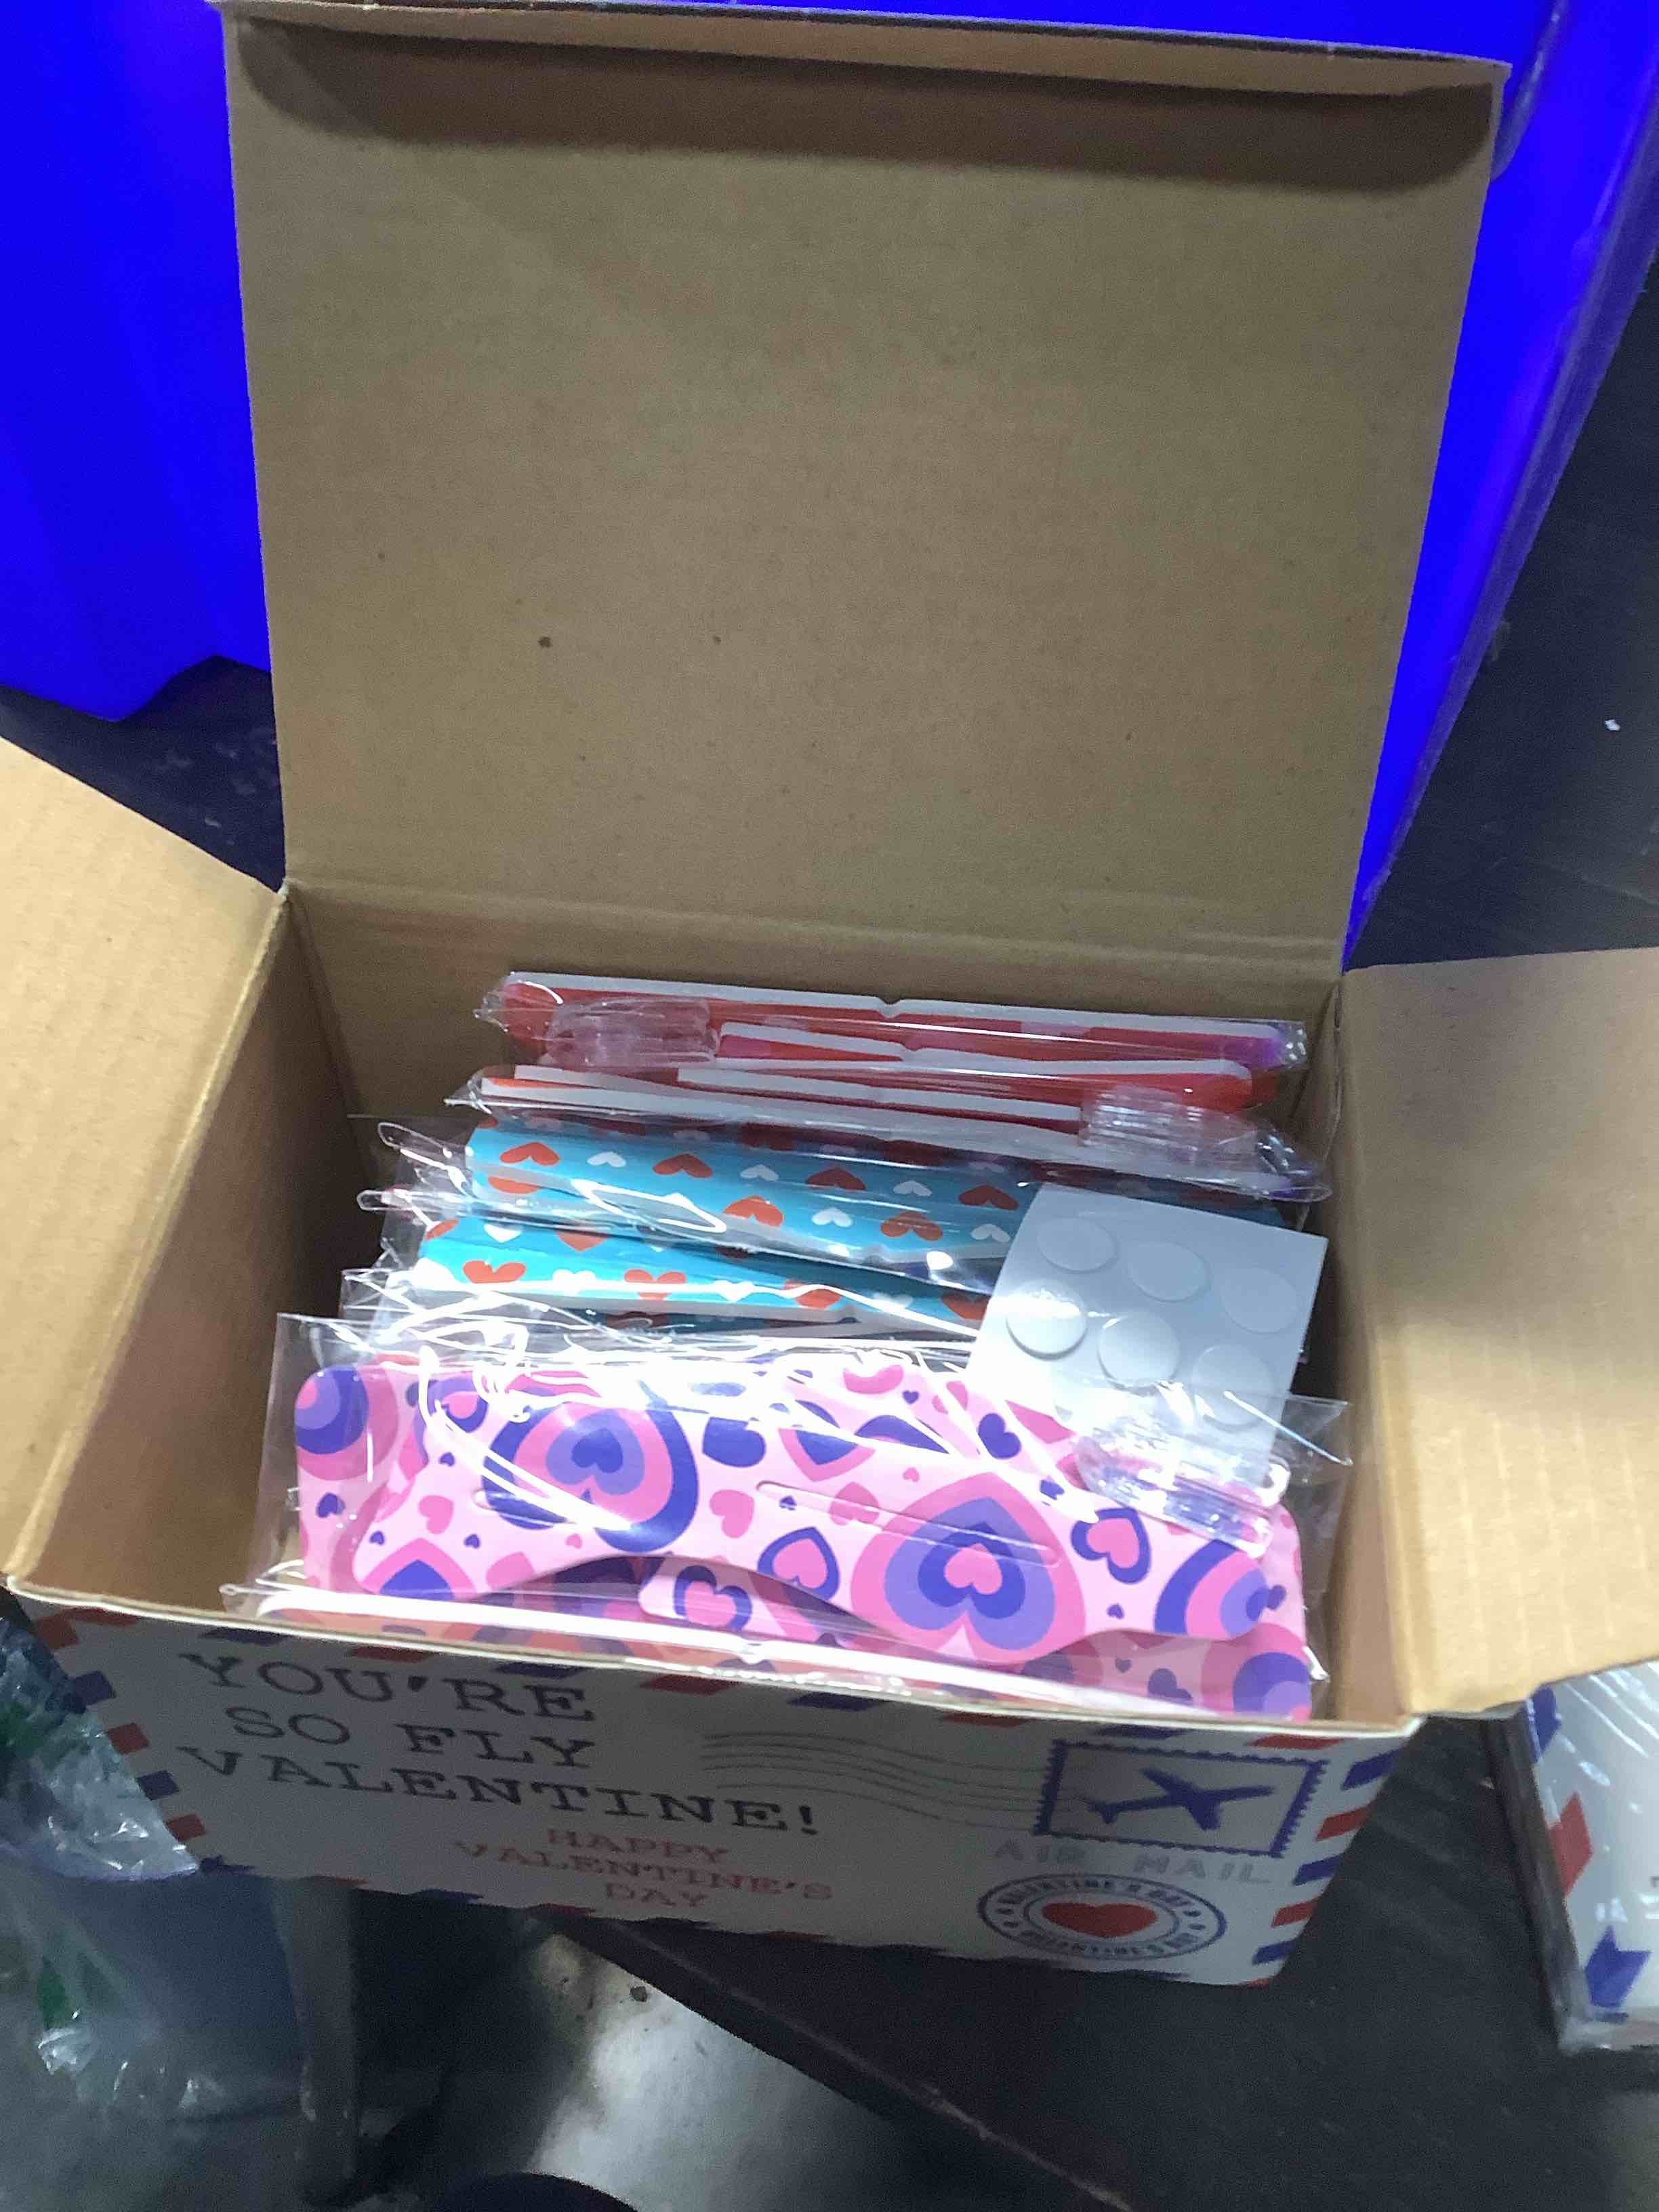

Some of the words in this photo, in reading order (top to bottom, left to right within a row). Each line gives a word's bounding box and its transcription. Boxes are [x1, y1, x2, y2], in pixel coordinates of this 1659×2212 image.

[178, 1652, 596, 1722] YOU'RE
[224, 1706, 350, 1746] SO
[395, 1723, 596, 1768] FLY
[176, 1745, 819, 1836] VALENTINE!
[546, 1829, 729, 1865] HAPPY
[1132, 1847, 1273, 1885] MAIL
[605, 1883, 709, 1908] DAY
